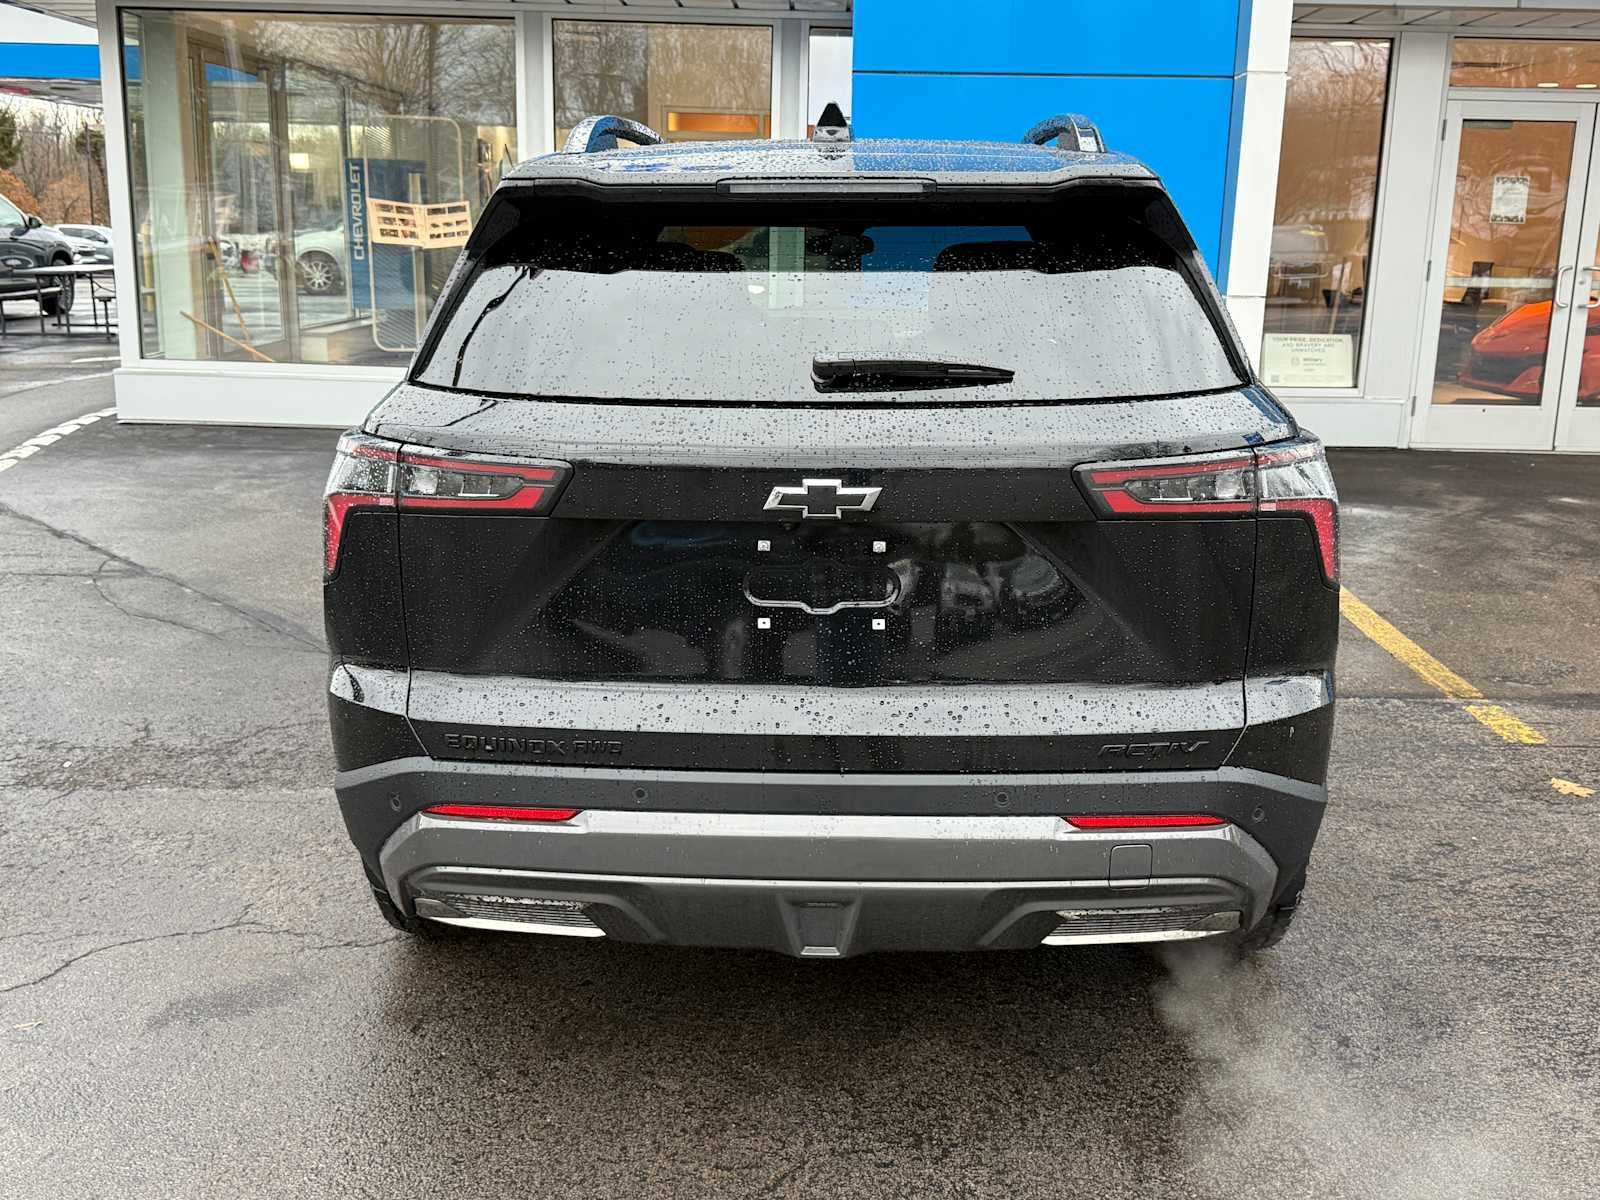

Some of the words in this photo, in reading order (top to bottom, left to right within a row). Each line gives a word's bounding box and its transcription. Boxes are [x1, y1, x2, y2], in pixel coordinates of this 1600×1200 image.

[349, 162, 365, 260] CHEVROLET
[445, 733, 566, 755] EQUINOX
[572, 740, 623, 754] AWD
[1098, 740, 1210, 757] ACTIV
